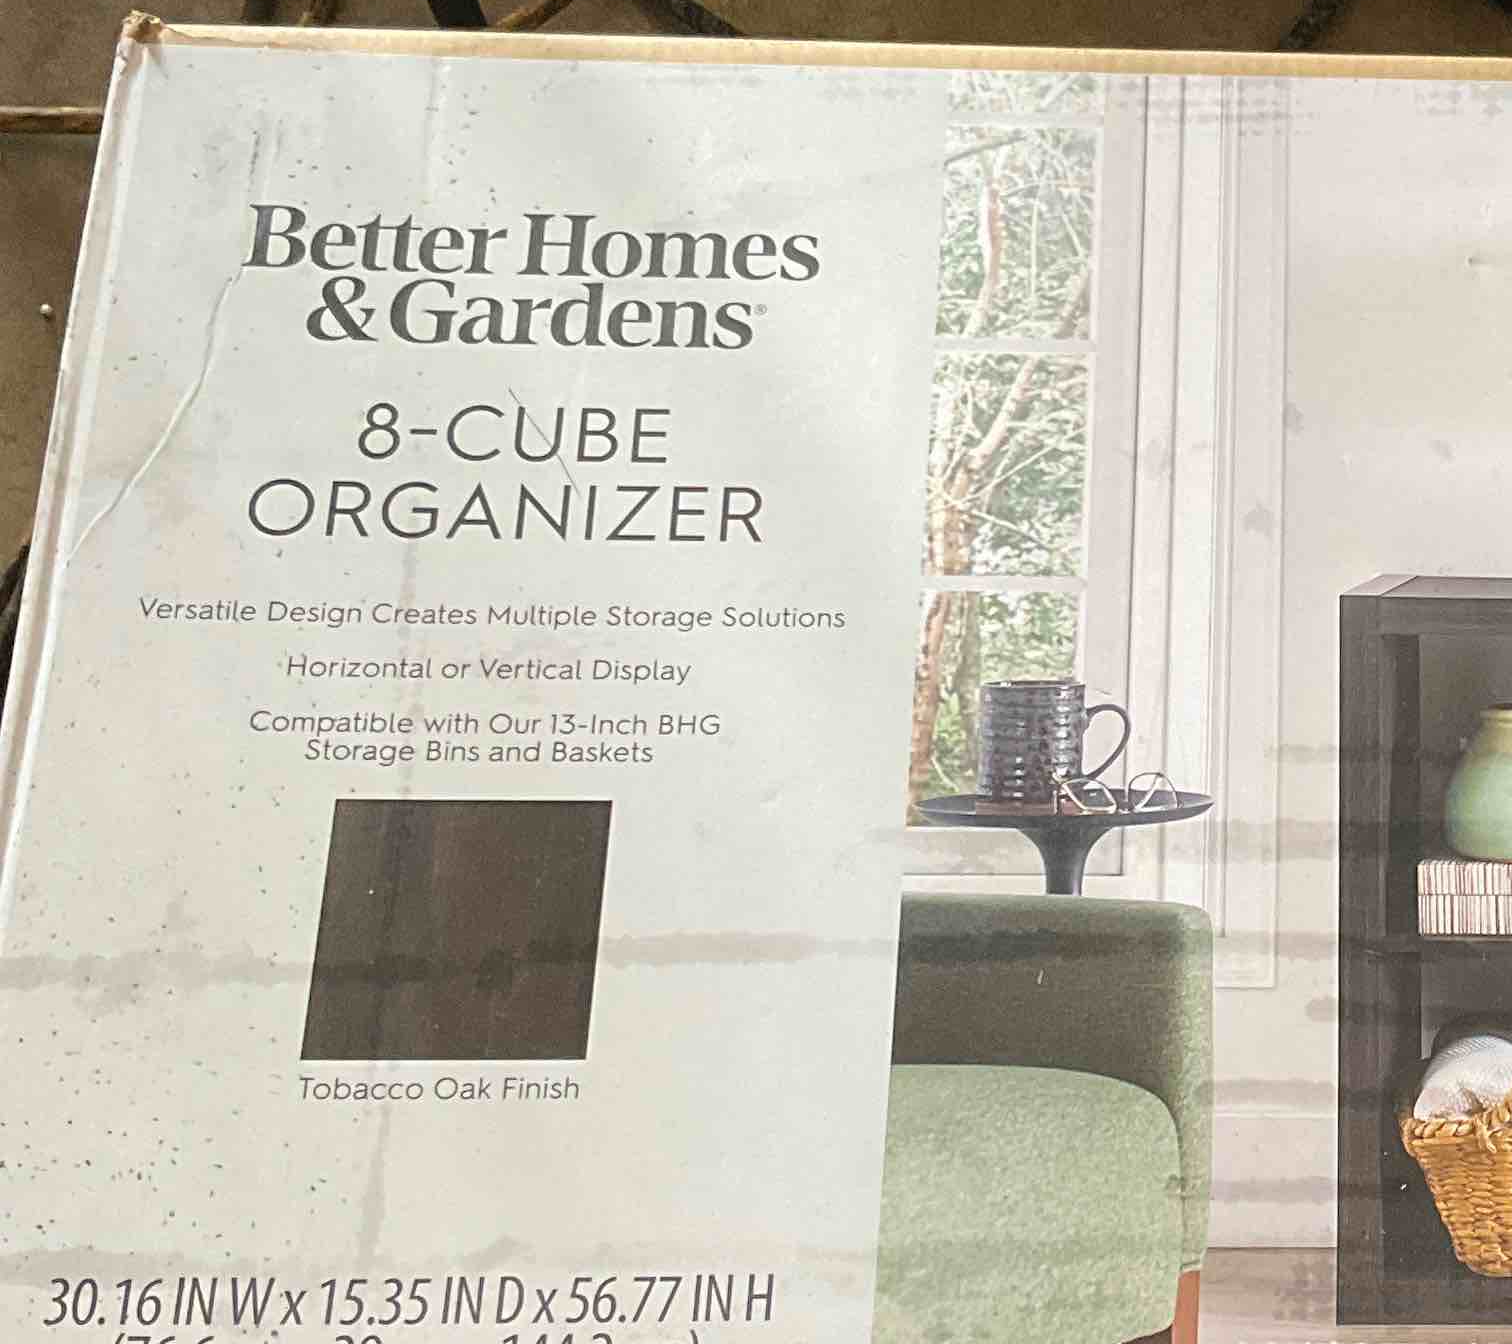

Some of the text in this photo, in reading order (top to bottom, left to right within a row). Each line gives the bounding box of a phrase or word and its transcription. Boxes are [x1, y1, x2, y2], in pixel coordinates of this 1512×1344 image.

[240, 203, 820, 281] Better Homes
[358, 402, 671, 463] 8-CUBE
[248, 478, 763, 543] ORGANIZER
[139, 597, 845, 632] Versatile Design Creates Multiple Storage Solutions
[287, 653, 691, 686] Horizontal or Vertical Display
[250, 711, 720, 737] Compatible with Our 13-Inch BHG
[304, 739, 653, 767] Storage Bins and Baskets
[299, 1075, 579, 1100] Tobacco Oak Finish
[43, 1273, 774, 1328] 30.16 IN W x 15.35 IN D x 56.77 IN H
